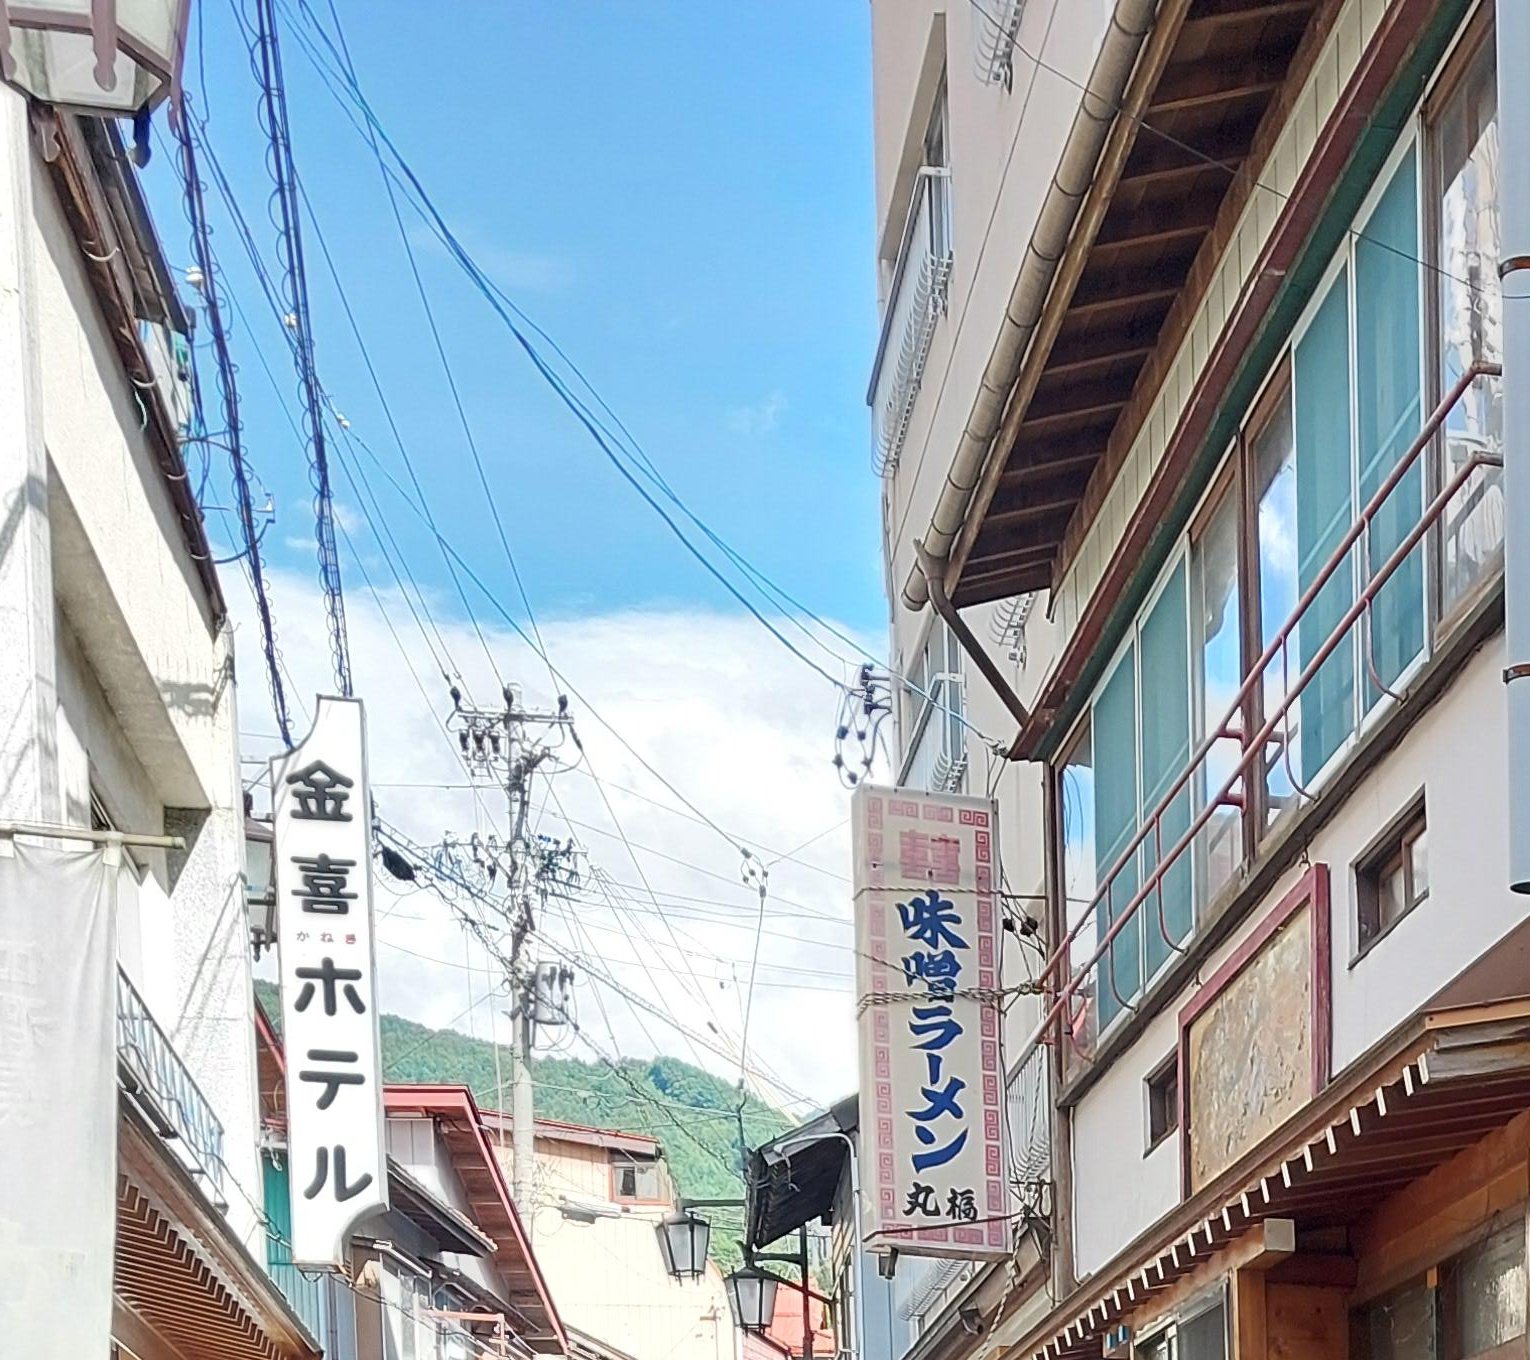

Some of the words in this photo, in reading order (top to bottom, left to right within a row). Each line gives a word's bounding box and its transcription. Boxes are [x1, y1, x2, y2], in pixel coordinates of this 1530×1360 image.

[286, 759, 373, 1202] 金喜ホテル
[896, 890, 971, 1175] 味噌ラーメン
